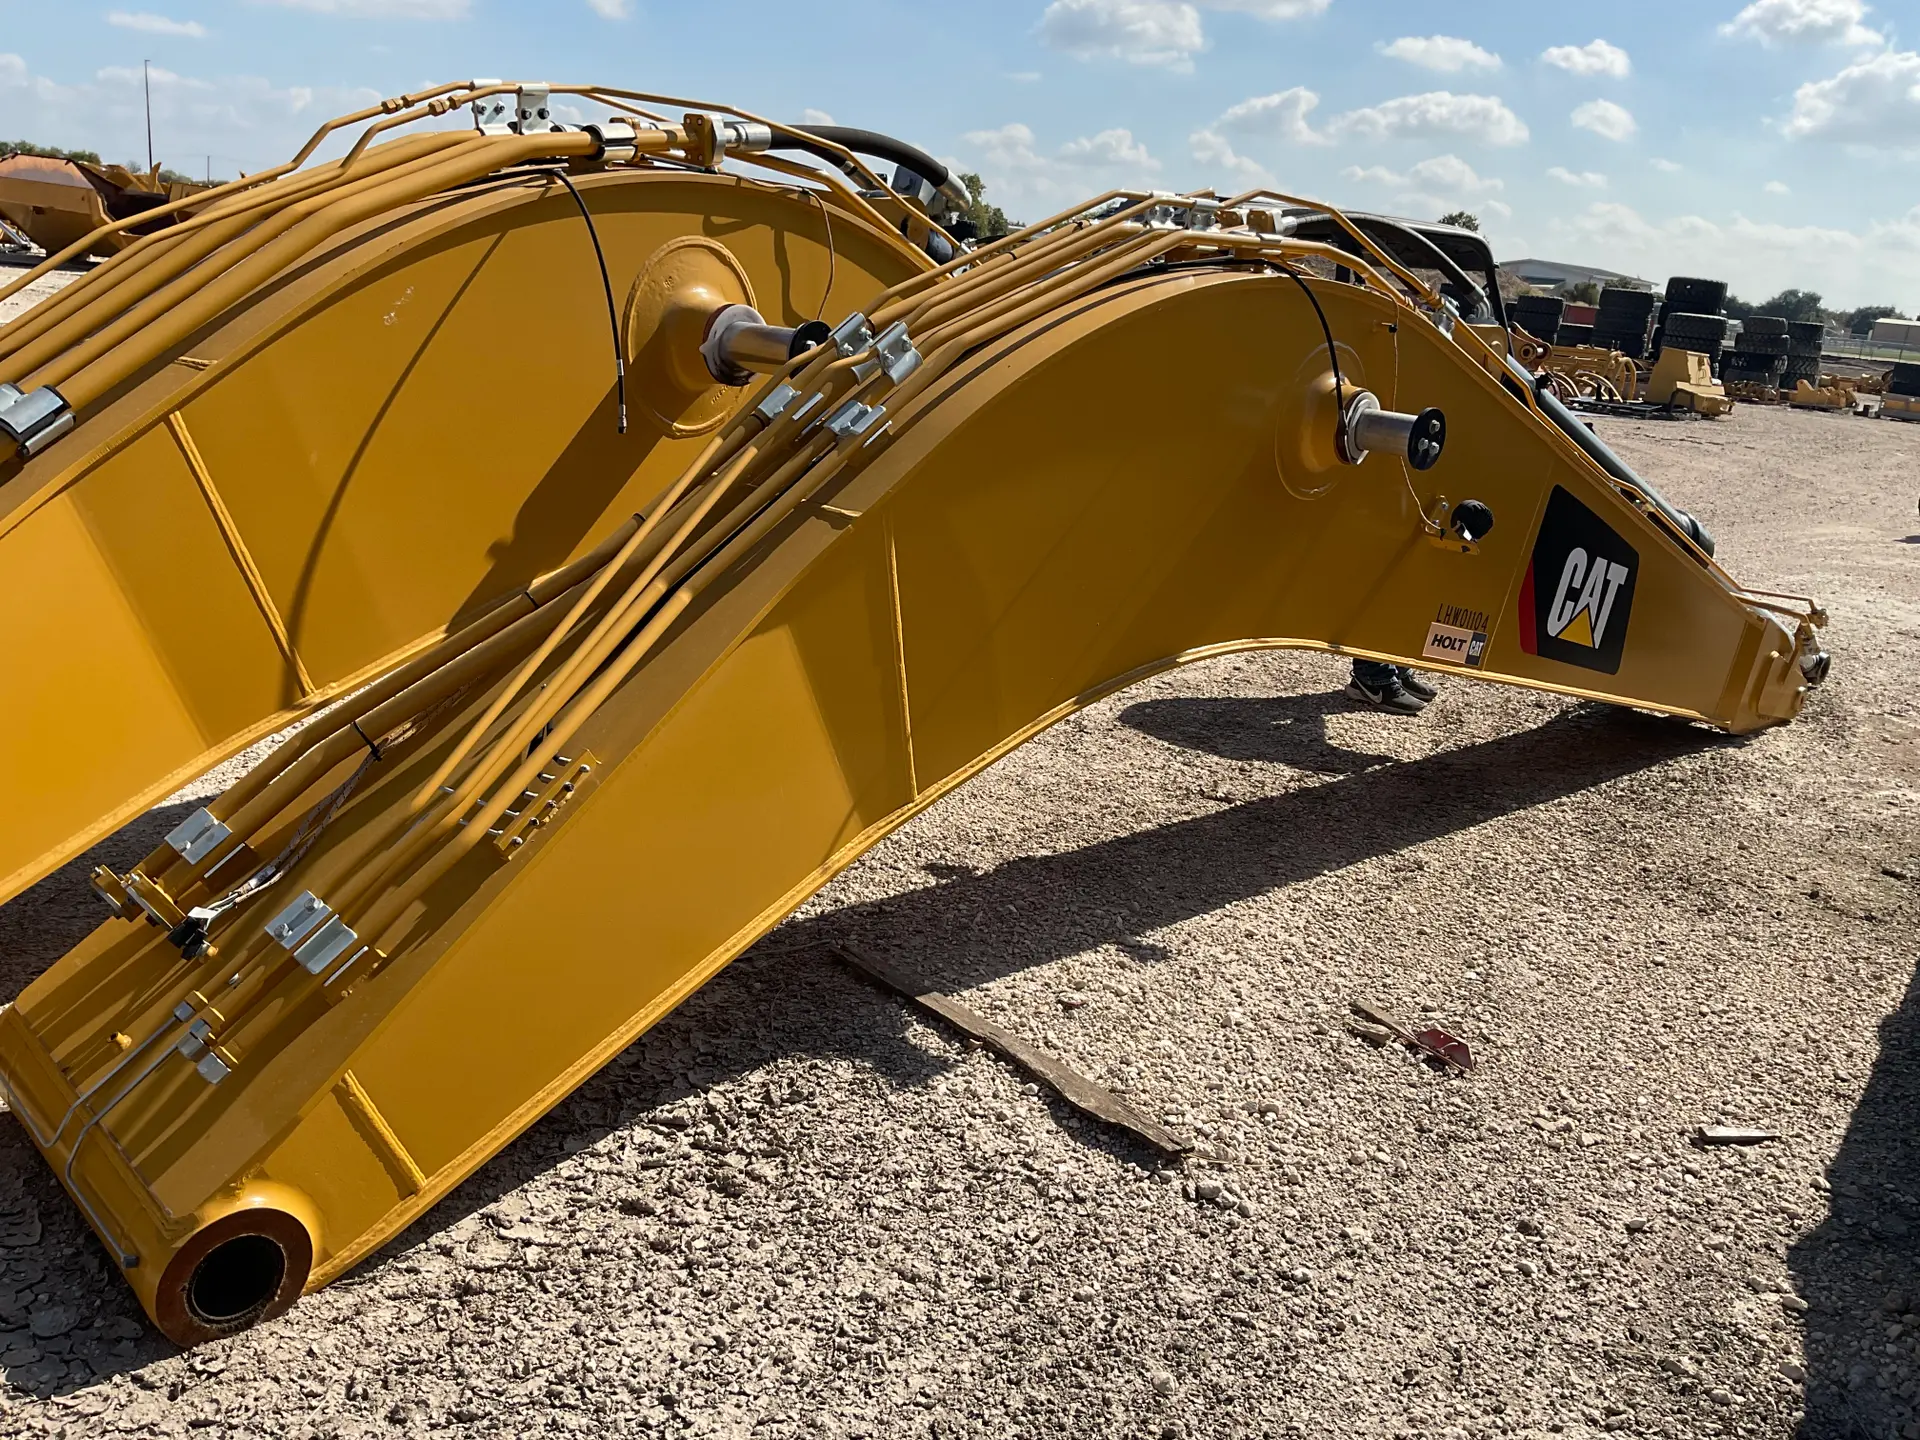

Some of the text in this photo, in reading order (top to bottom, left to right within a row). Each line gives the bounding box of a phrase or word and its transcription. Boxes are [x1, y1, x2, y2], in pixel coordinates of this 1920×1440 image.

[1547, 547, 1629, 650] CAT
[1431, 633, 1484, 656] HOLT CAT
